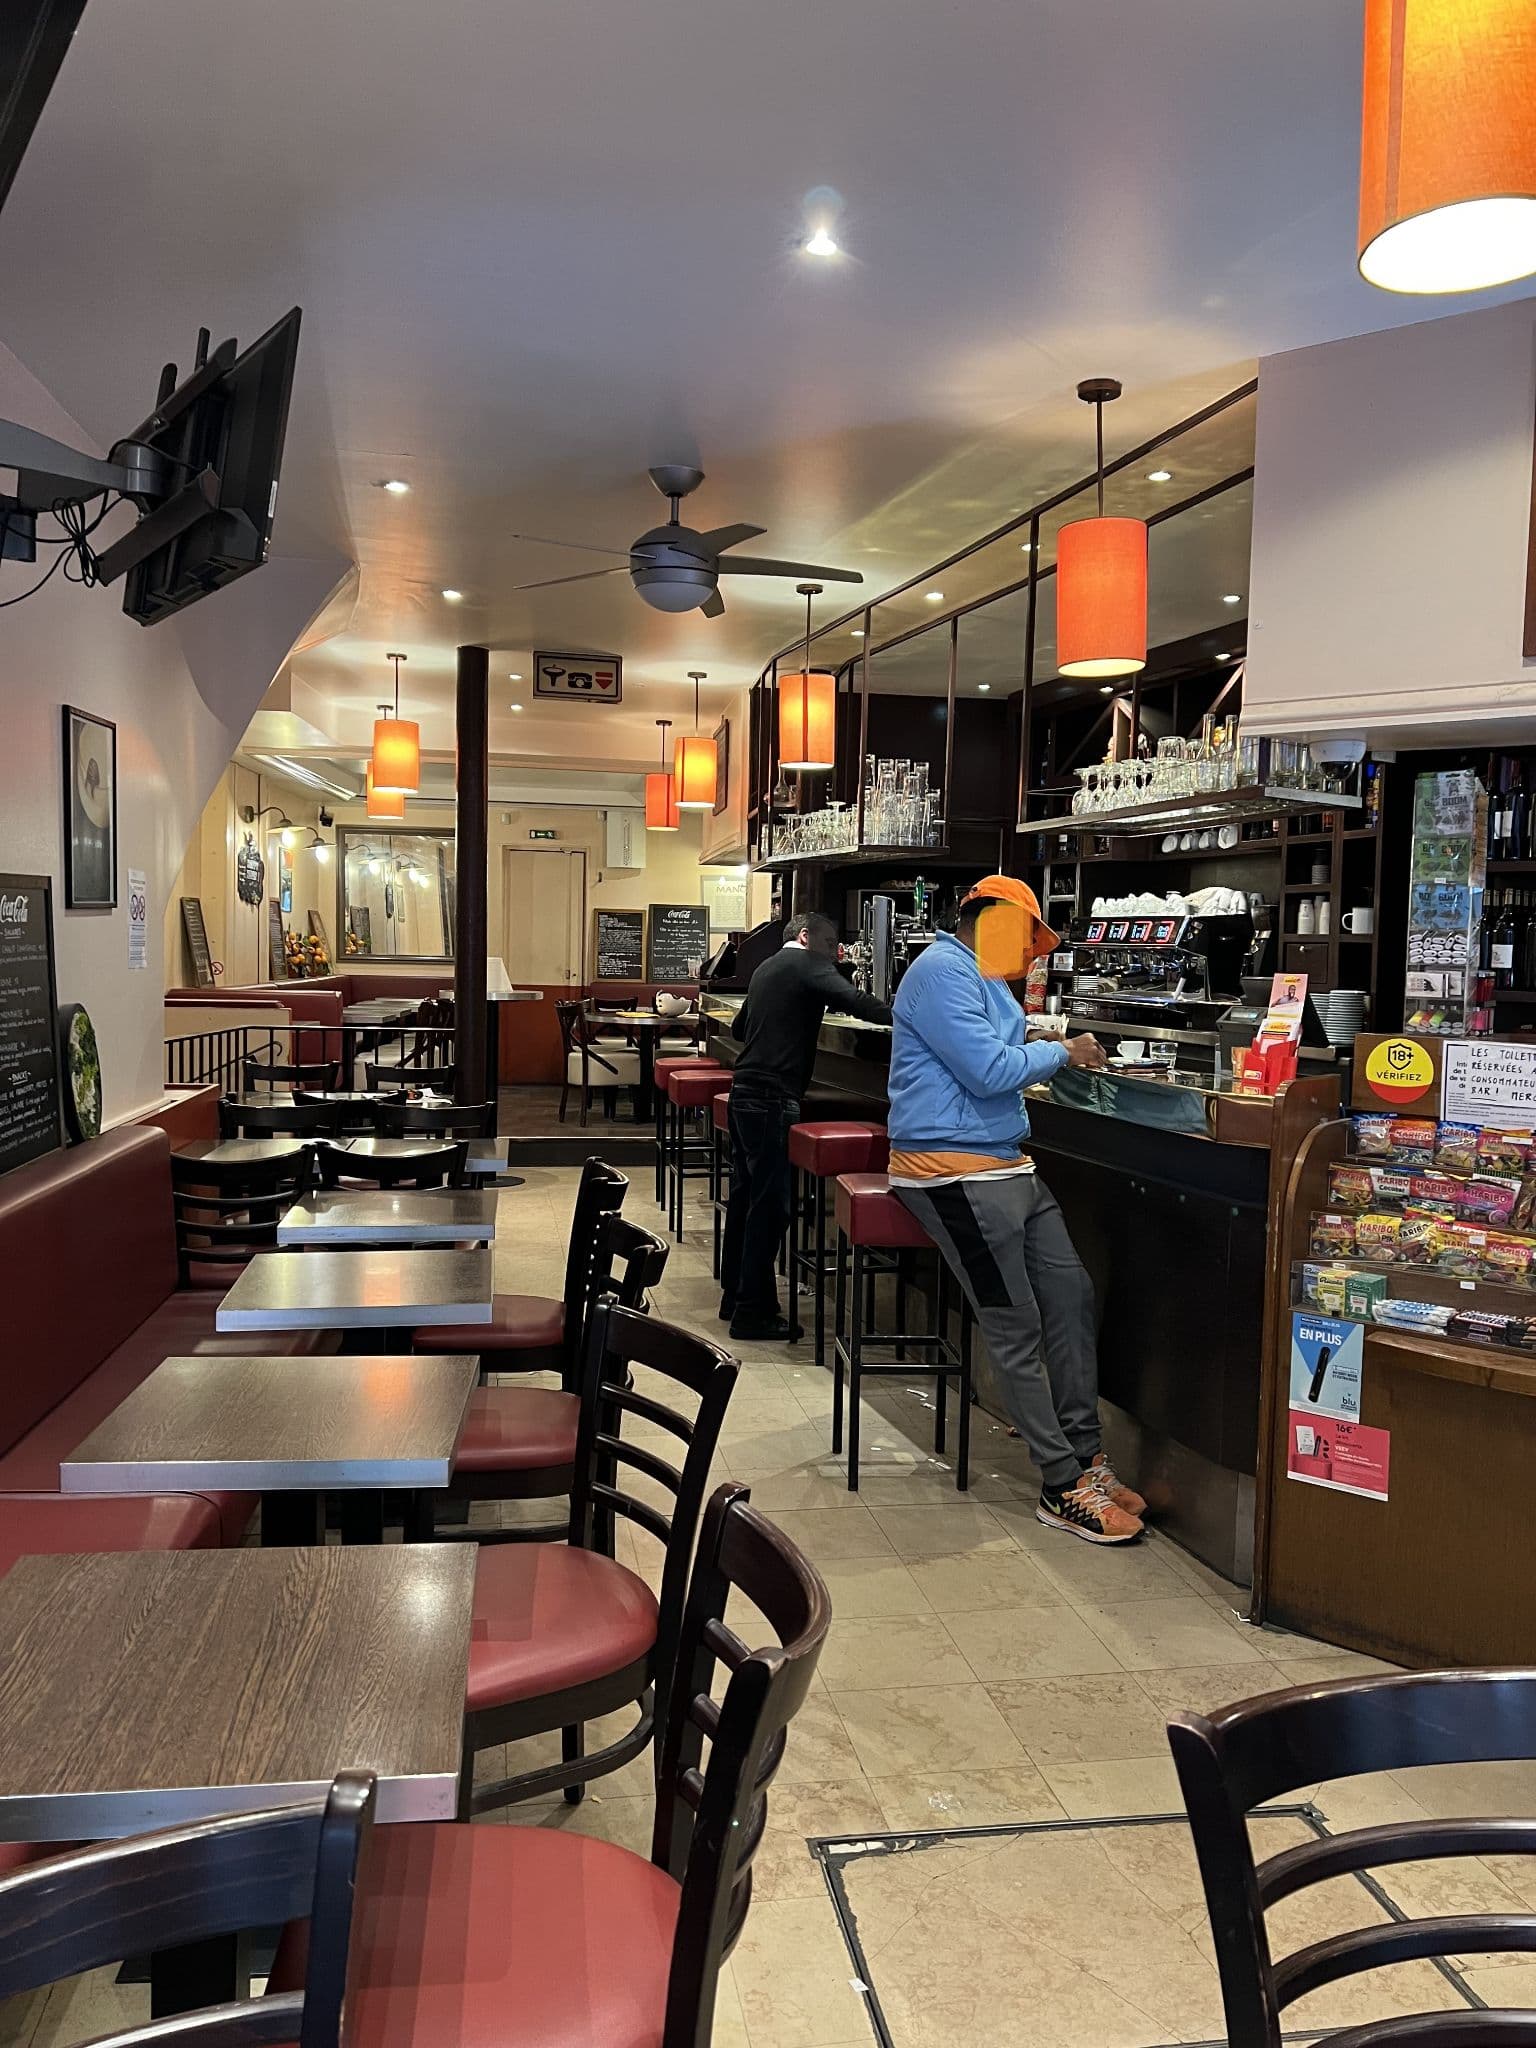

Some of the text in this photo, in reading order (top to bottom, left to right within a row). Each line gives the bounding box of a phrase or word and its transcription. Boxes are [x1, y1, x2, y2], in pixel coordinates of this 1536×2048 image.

[1391, 1049, 1414, 1061] 18+
[1471, 1048, 1489, 1057] LES
[1471, 1060, 1522, 1074] RÉSERVÉES
[1376, 1070, 1422, 1081] VÉRIFIEZ
[1471, 1086, 1490, 1096] BAR
[1442, 1127, 1477, 1139] HARIBO
[1377, 1175, 1409, 1186] HARIBO
[1416, 1180, 1456, 1194] HARIBO
[1471, 1189, 1509, 1203] HARIBO
[1360, 1223, 1393, 1234] HARIBO
[1490, 1243, 1529, 1258] HARIBO
[1300, 1328, 1342, 1345] EN PLUS
[1342, 1396, 1356, 1406] blu
